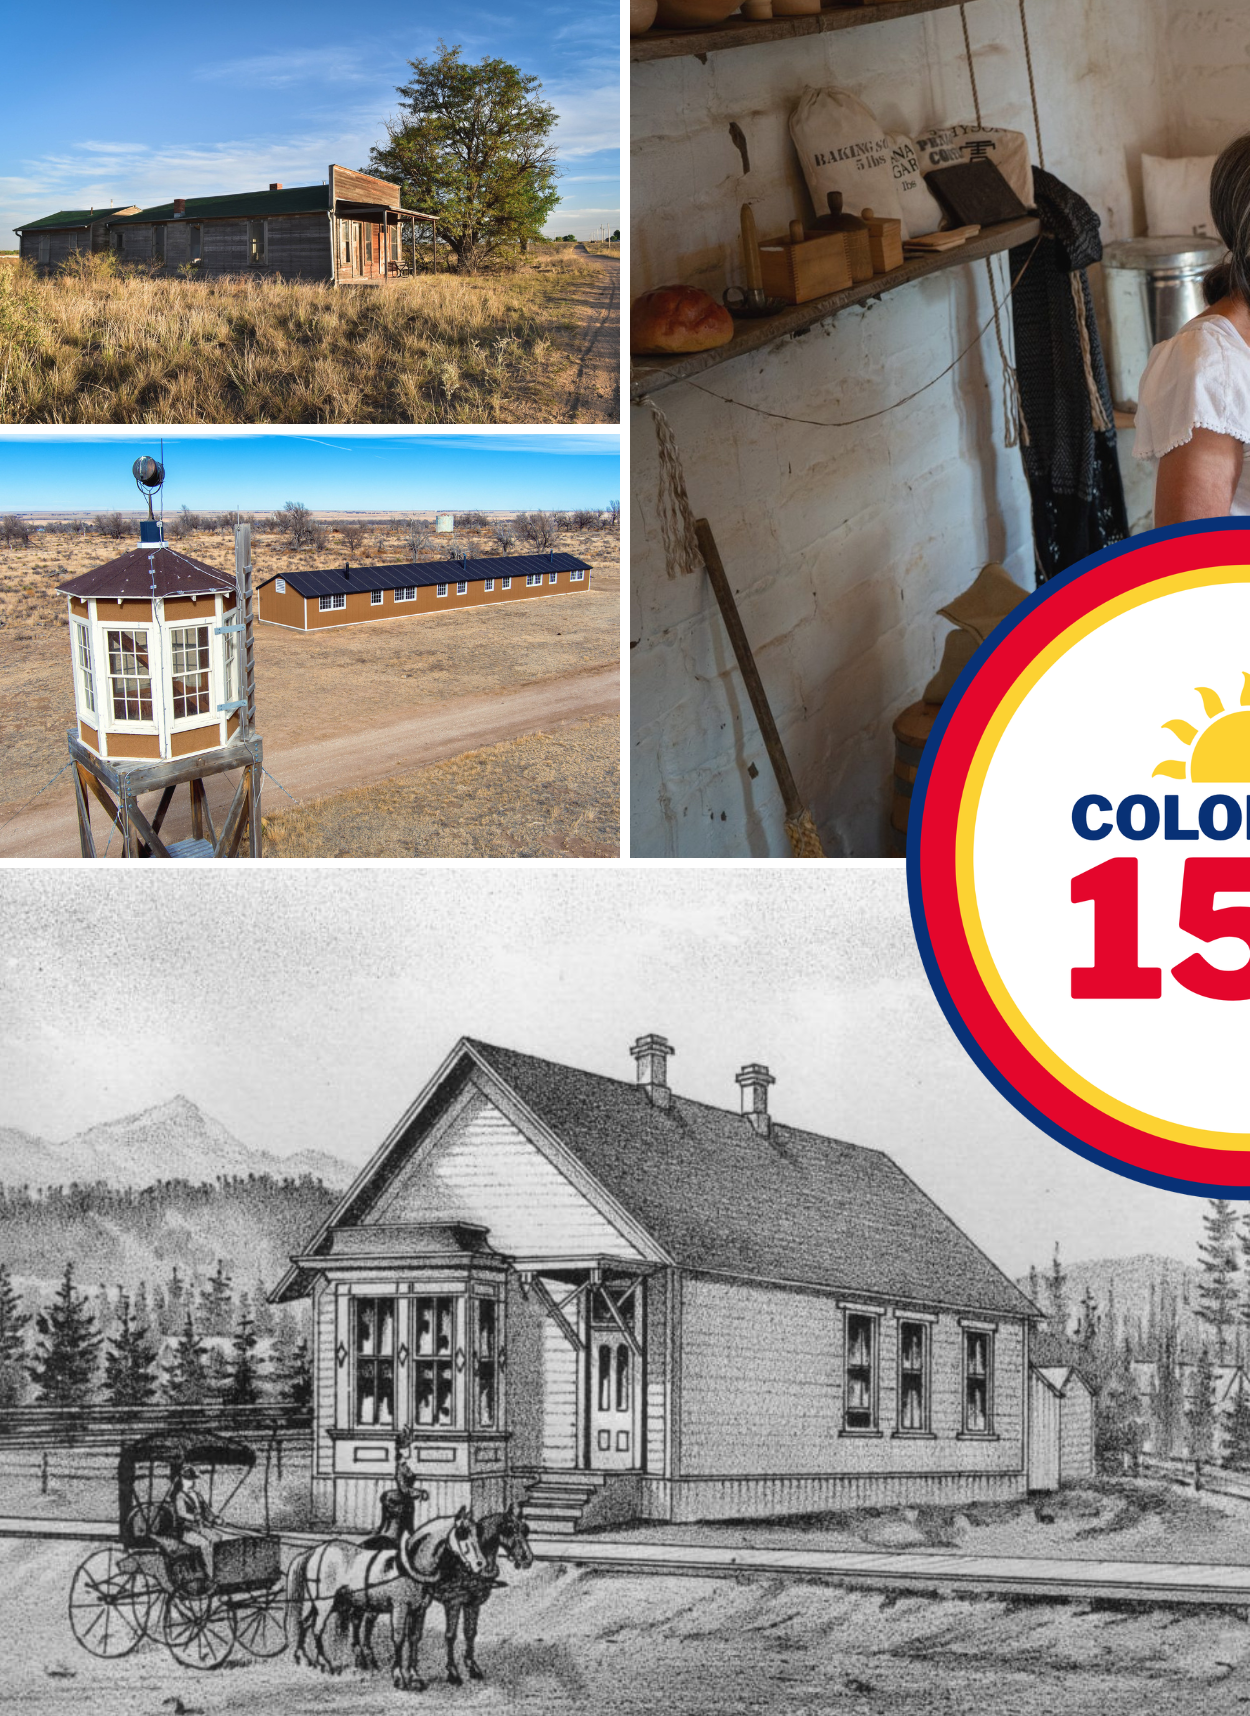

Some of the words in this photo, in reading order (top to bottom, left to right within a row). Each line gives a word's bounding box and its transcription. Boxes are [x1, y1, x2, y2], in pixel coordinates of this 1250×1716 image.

[814, 142, 874, 167] BAKING
[856, 158, 866, 171] 5
[865, 154, 887, 169] lbs
[902, 180, 917, 192] lbs
